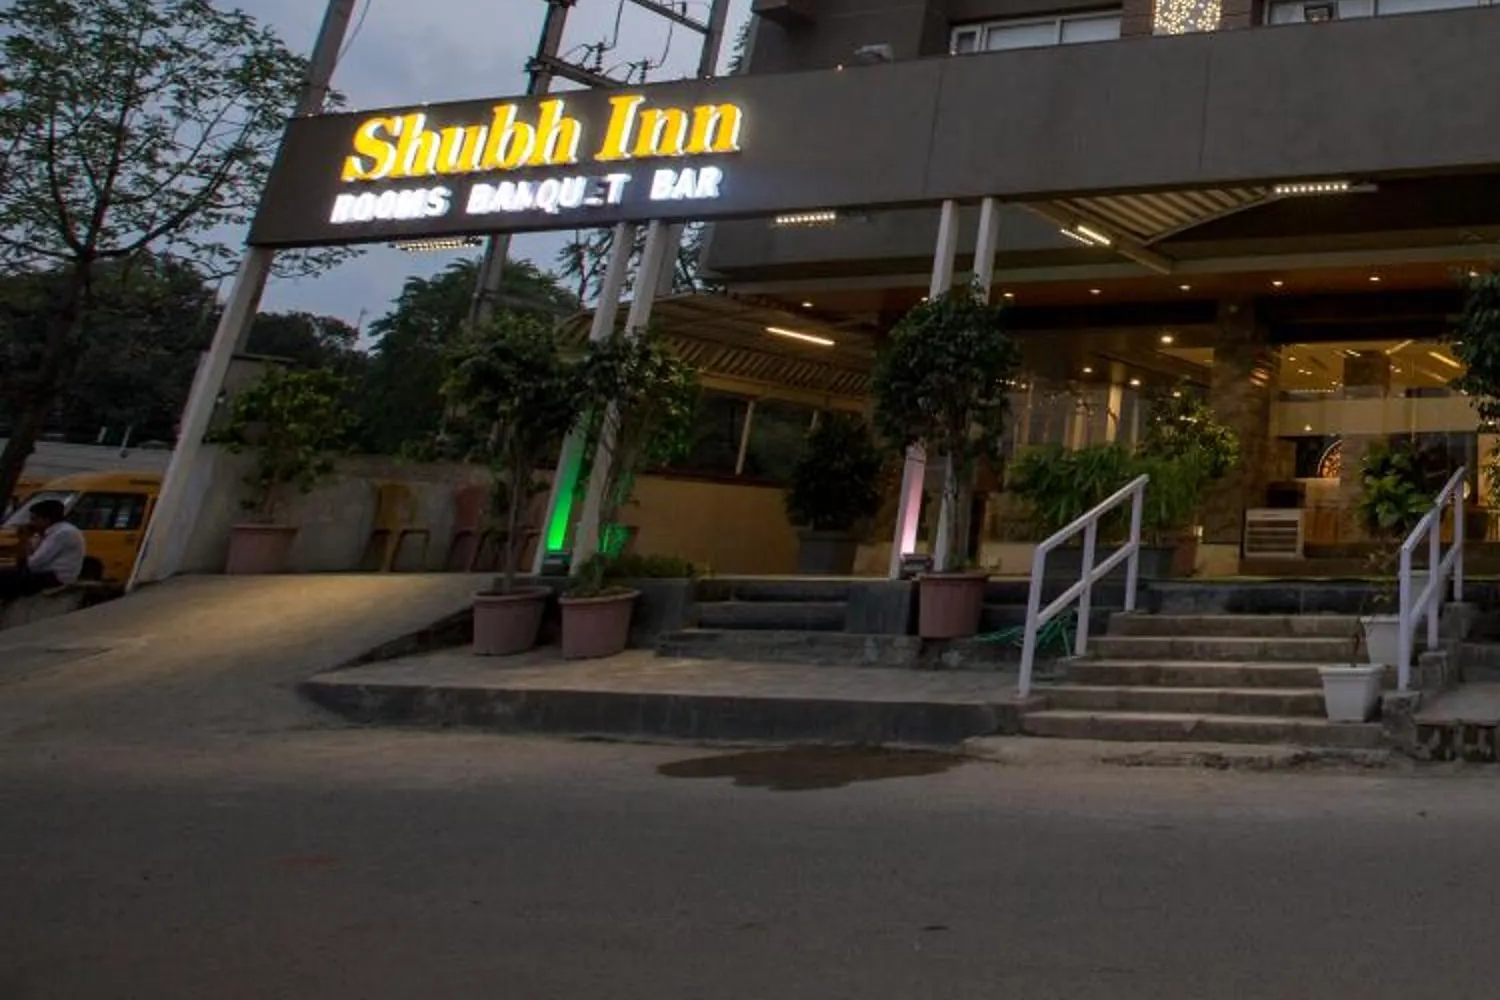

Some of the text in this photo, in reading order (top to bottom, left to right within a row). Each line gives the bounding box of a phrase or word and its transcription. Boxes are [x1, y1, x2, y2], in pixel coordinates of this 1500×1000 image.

[341, 94, 742, 182] Shubh Inn
[329, 186, 452, 224] ROOMS
[650, 166, 724, 200] BAR
